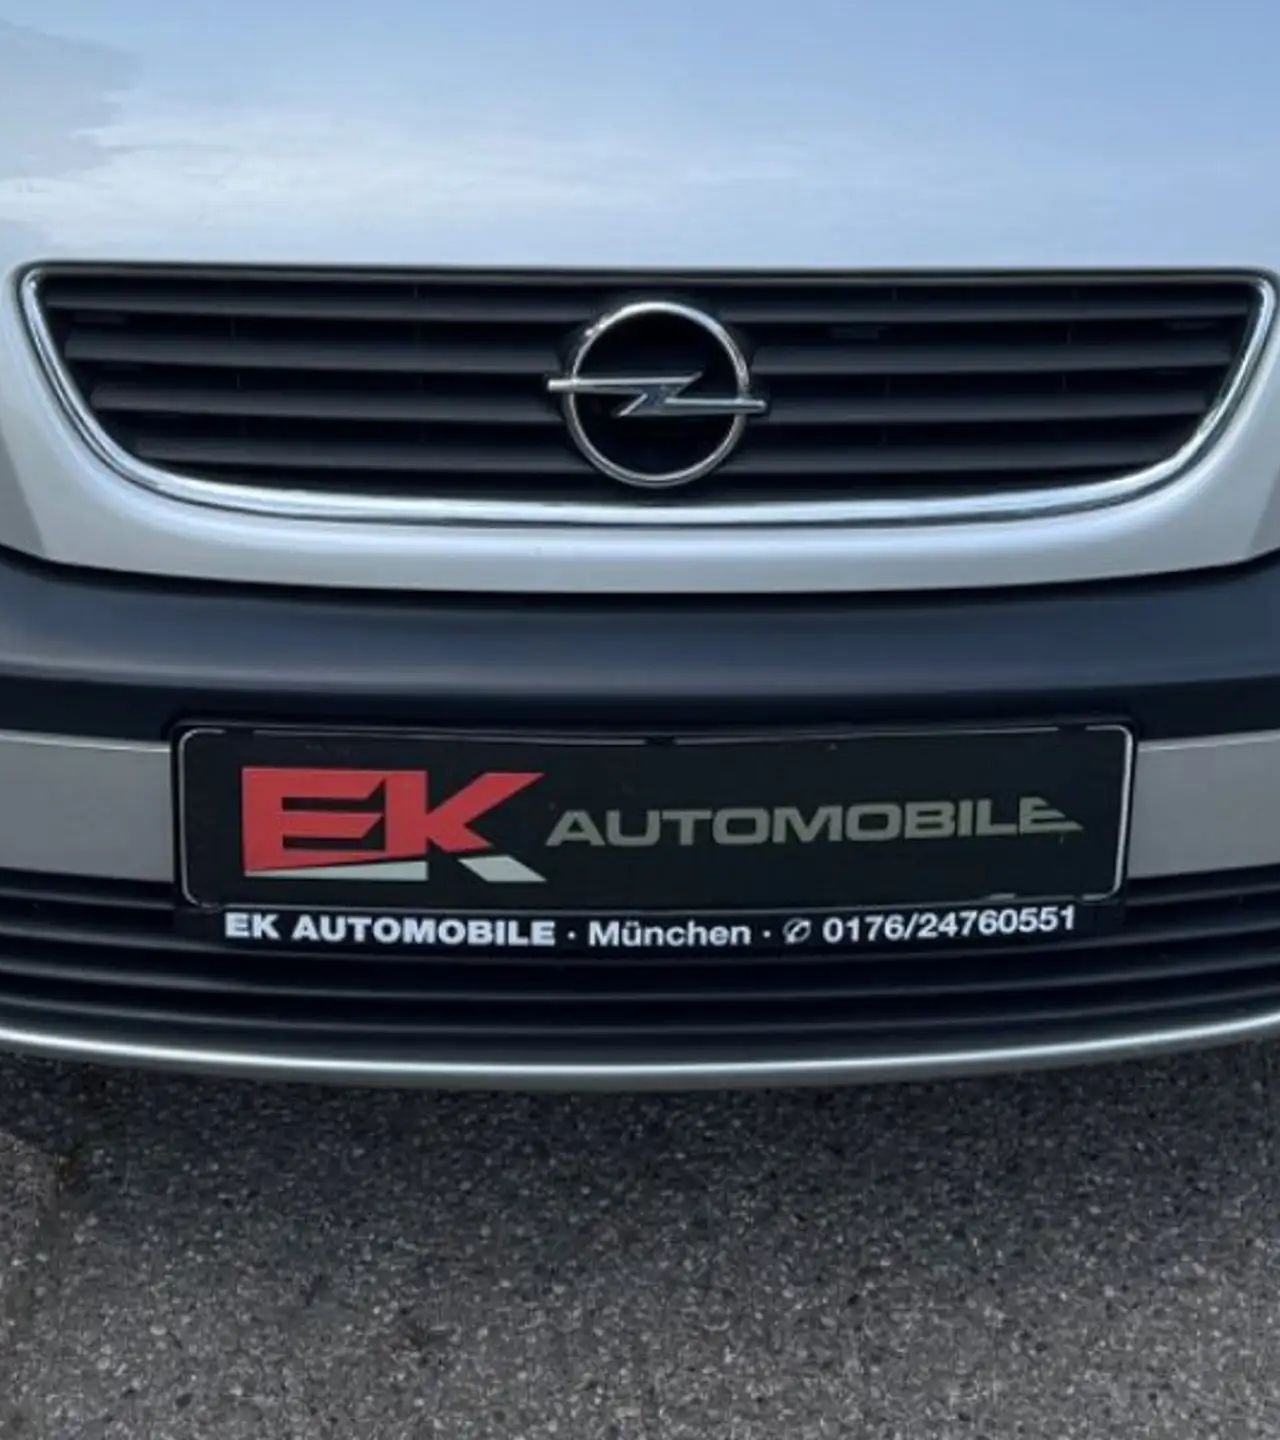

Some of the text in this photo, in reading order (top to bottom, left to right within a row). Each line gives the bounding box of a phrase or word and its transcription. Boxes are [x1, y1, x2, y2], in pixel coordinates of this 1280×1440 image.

[242, 767, 1084, 882] EK AUTOMOBILE
[225, 905, 1076, 947] EK AUTOMOBILE München 0176/24760551
